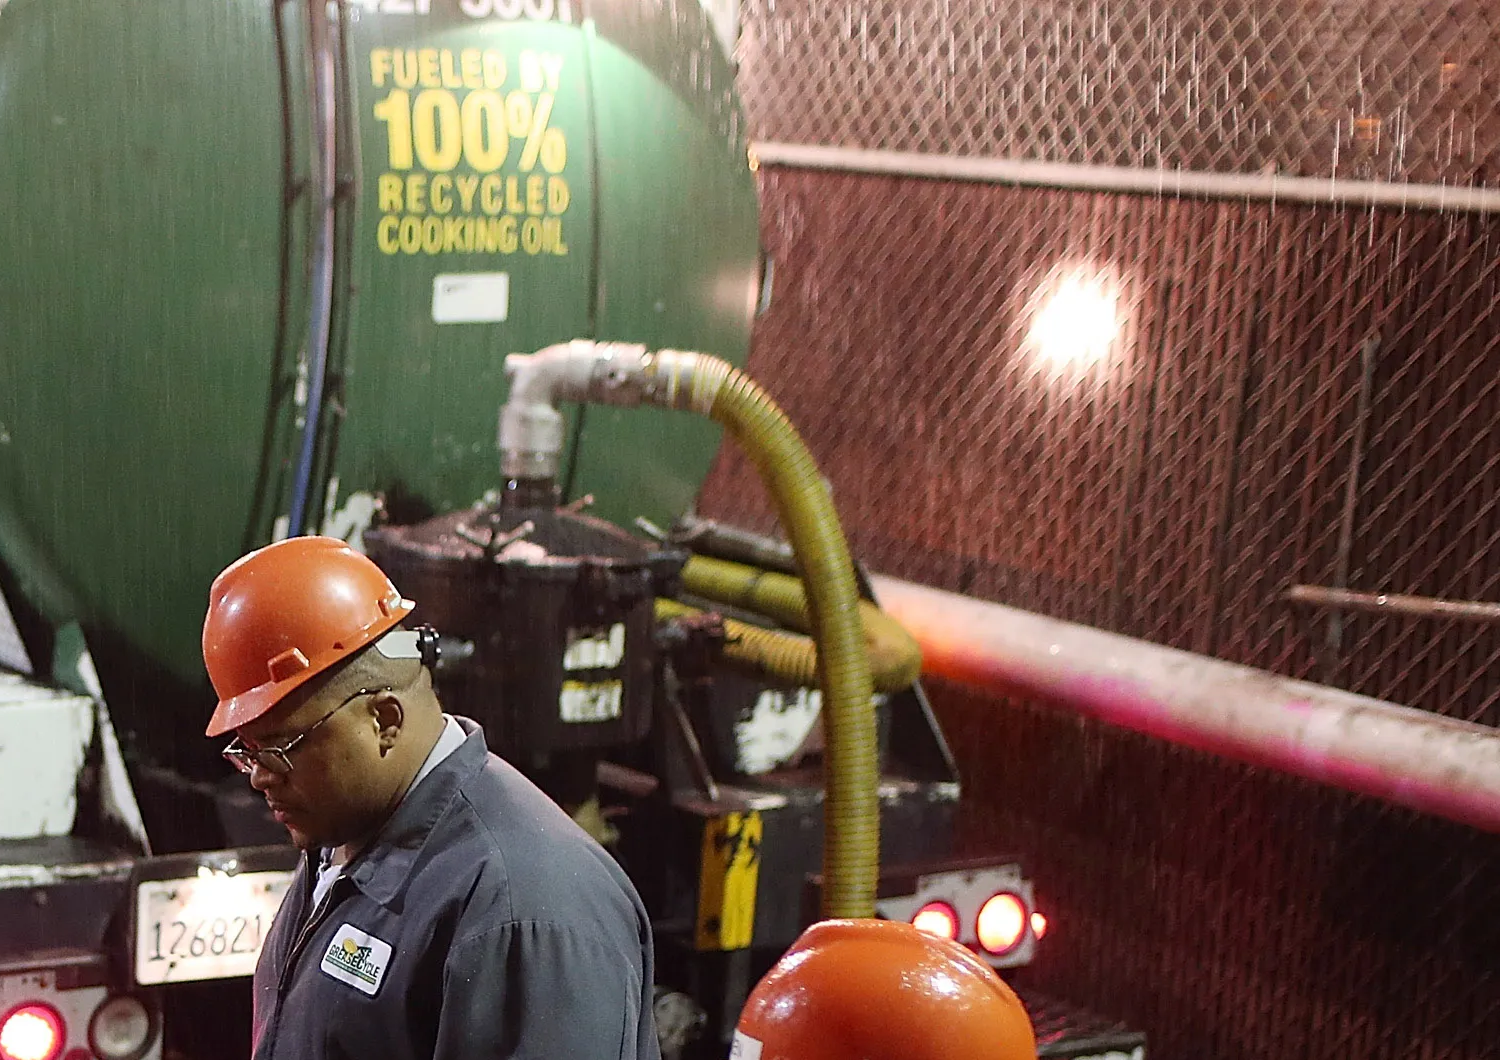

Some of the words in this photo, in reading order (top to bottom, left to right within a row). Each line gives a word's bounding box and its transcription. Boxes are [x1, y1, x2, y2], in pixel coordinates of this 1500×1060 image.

[370, 48, 508, 89] FUELED
[519, 48, 565, 93] BY
[374, 88, 568, 174] 100%
[377, 173, 571, 216] RECYCLED
[377, 215, 518, 255] COOKING
[522, 216, 569, 256] OIL
[329, 944, 381, 978] GREASECYCLE
